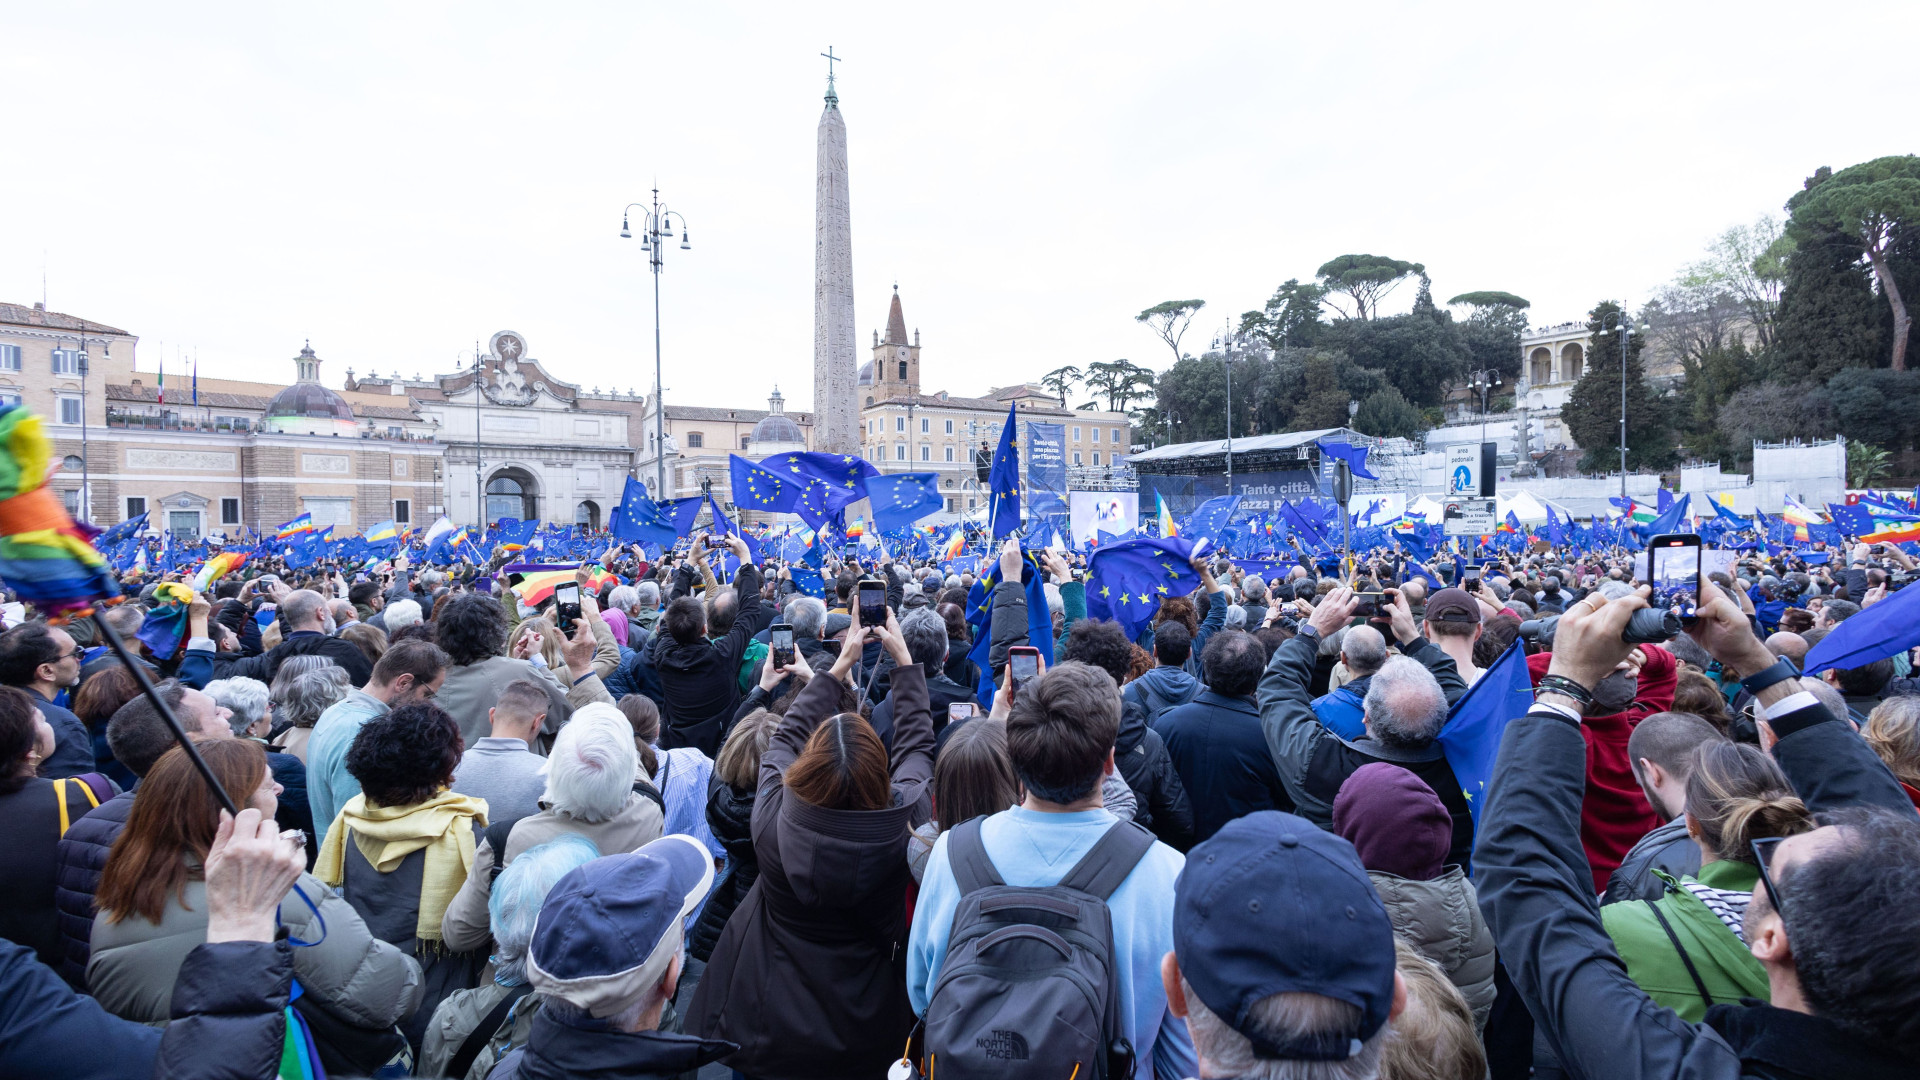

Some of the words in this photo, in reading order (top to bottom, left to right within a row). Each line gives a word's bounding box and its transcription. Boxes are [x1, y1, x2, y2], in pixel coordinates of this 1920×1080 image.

[1241, 484, 1276, 496] Tante
[1280, 481, 1314, 495] città,
[1876, 520, 1914, 534] ACE
[992, 1030, 1010, 1040] THE
[976, 1038, 1010, 1048] NORTH
[986, 1049, 1010, 1060] FACE
